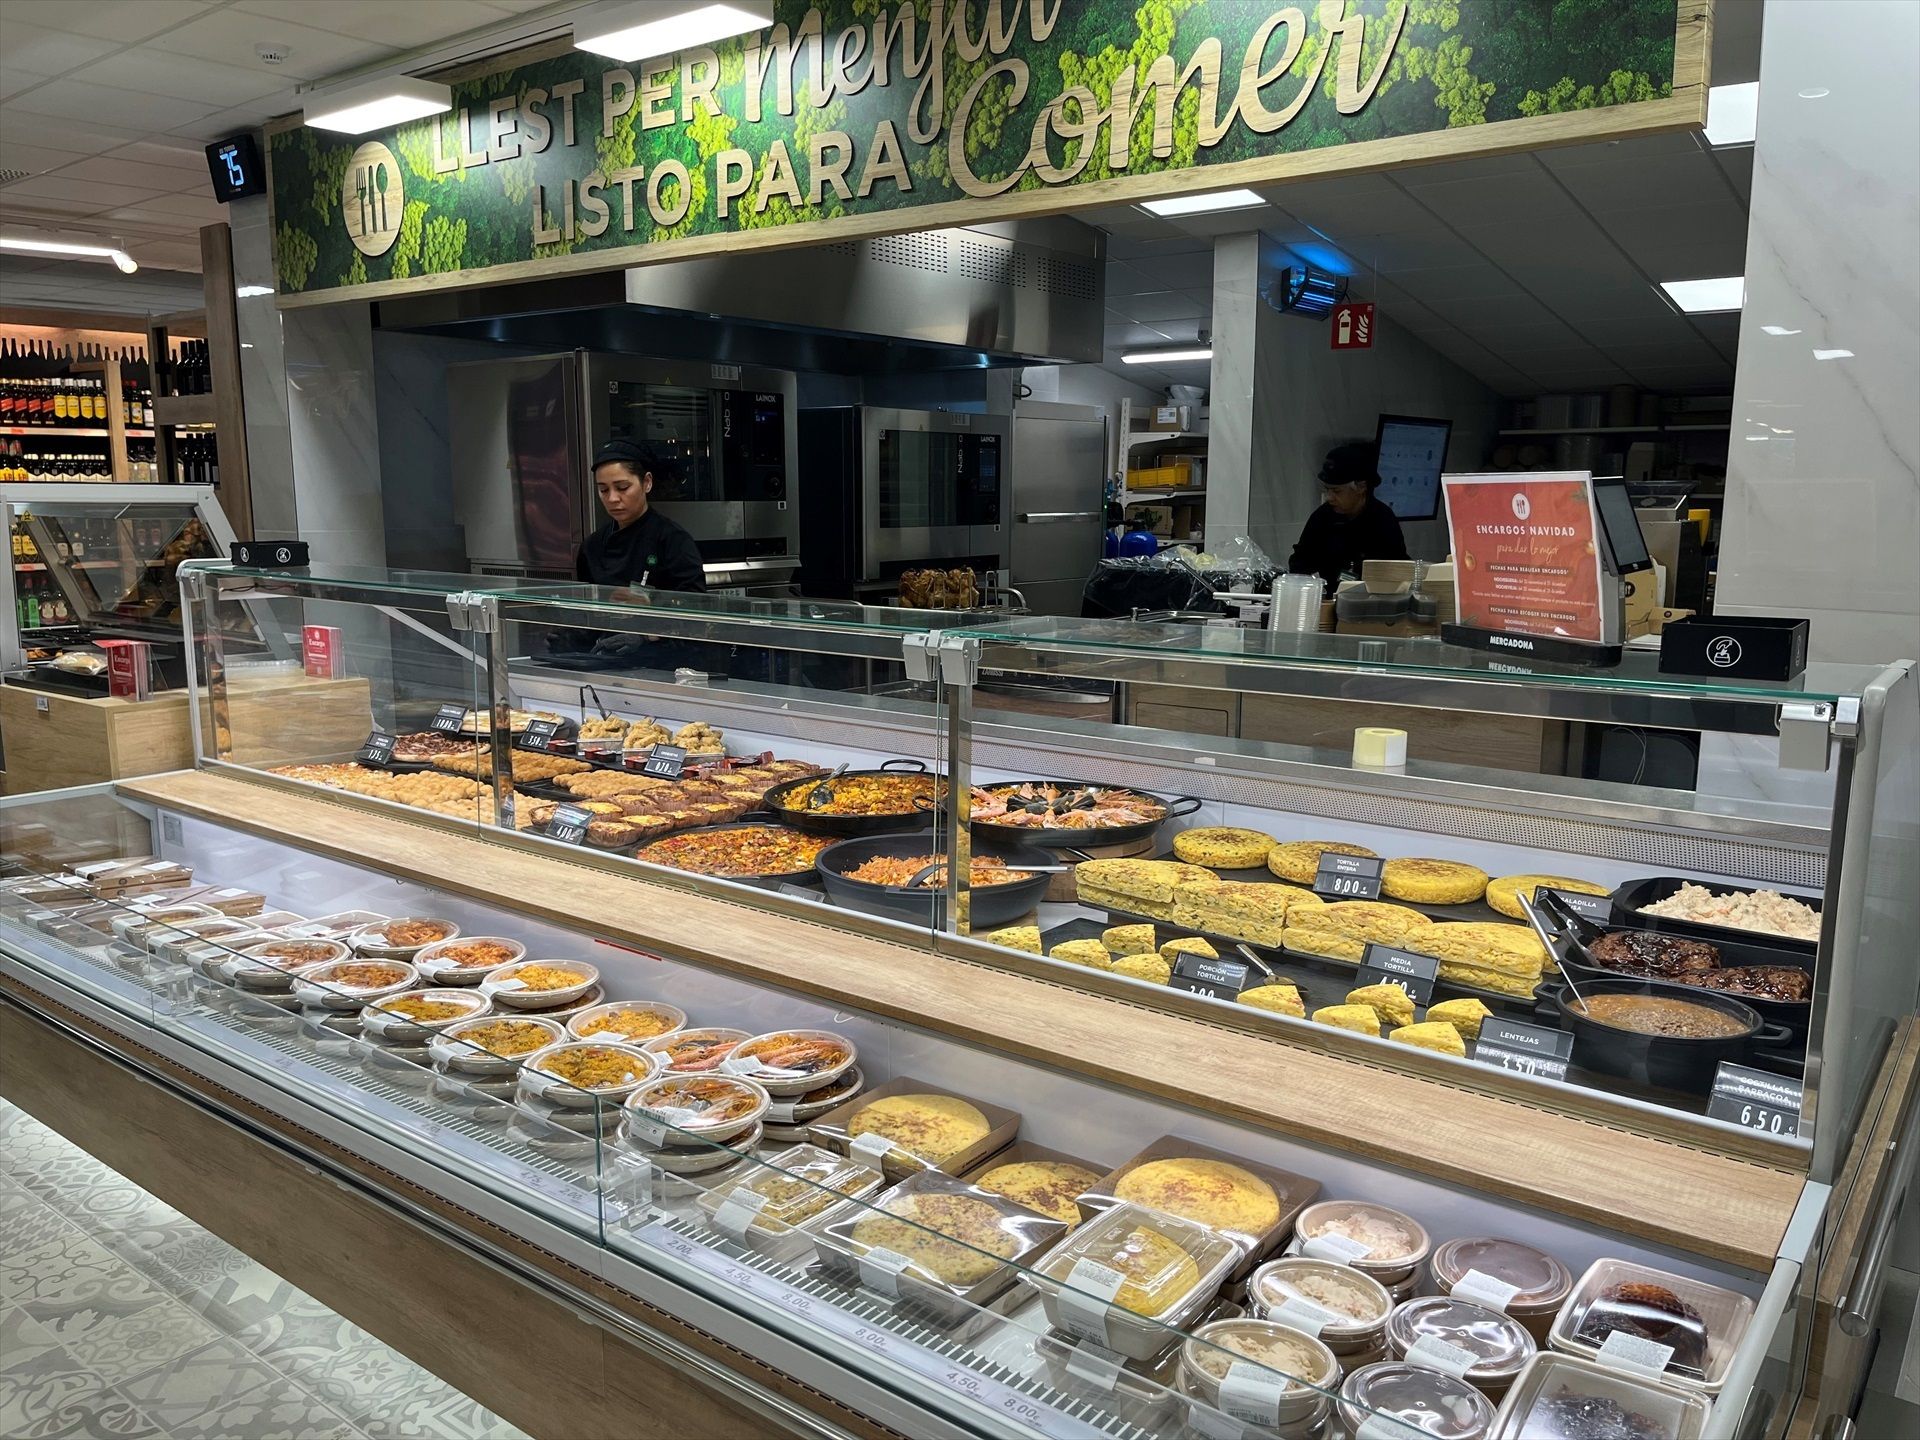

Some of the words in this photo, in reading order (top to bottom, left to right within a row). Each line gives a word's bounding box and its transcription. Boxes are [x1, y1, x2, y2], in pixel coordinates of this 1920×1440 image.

[432, 78, 584, 174] LLEST
[602, 48, 722, 138] PER
[533, 158, 692, 246] LISTO
[716, 119, 912, 219] PARA
[948, 0, 1408, 198] Comer
[1476, 525, 1525, 535] ENCARGOS
[1529, 526, 1575, 537] NAVIDAD
[1489, 636, 1534, 650] MERCADONA
[1336, 859, 1360, 867] TORTILLA
[1390, 956, 1412, 967] MEDIA
[1198, 964, 1227, 976] PORCIÓN
[1383, 962, 1415, 975] TORTILLA
[1196, 971, 1225, 982] TORTILLA
[1499, 1031, 1540, 1045] LENTEJAS
